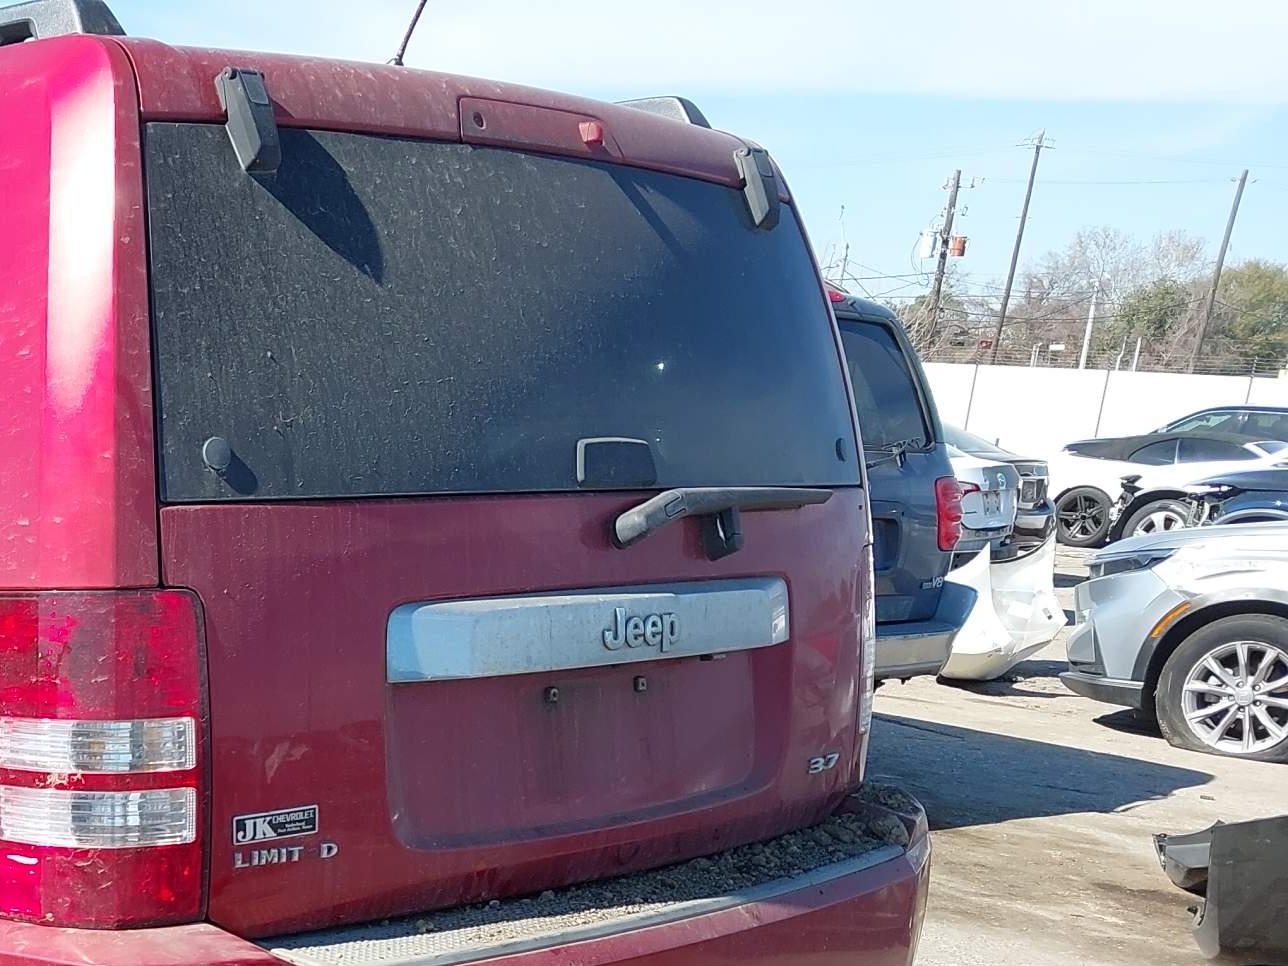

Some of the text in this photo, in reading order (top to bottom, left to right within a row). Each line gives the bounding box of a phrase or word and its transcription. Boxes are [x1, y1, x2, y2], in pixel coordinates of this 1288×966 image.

[602, 607, 680, 652] Jeep
[237, 817, 277, 841] JK
[272, 809, 315, 824] CHEVROLET
